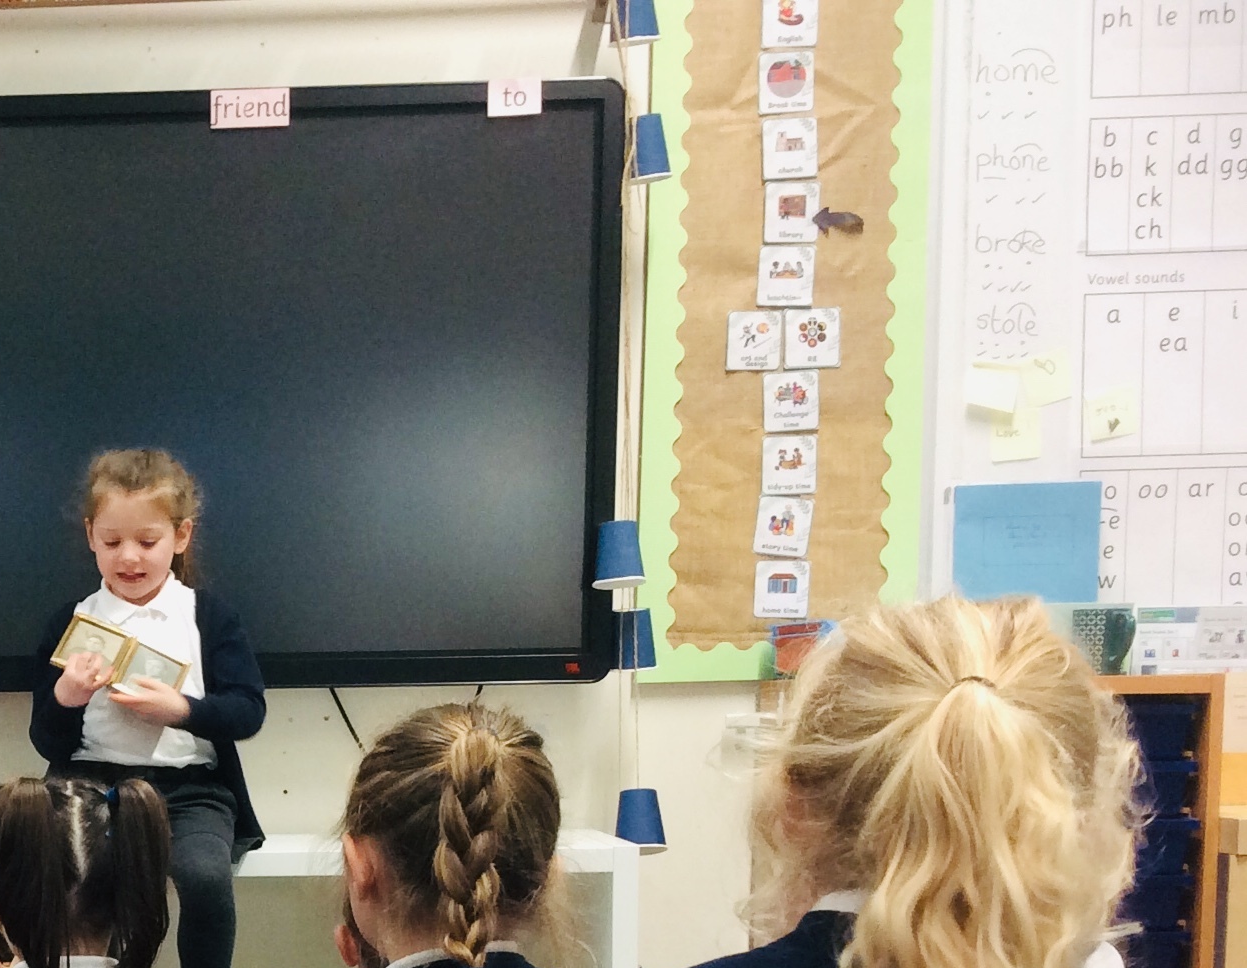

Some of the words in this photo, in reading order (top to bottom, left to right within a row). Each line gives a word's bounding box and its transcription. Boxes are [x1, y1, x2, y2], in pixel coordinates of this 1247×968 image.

[1101, 5, 1133, 35] ph
[1156, 4, 1178, 27] le
[1198, 2, 1236, 25] mb
[975, 54, 1059, 85] home
[502, 86, 527, 108] to
[211, 92, 288, 126] friend
[1103, 125, 1117, 148] b
[1187, 122, 1201, 145] d
[1229, 126, 1242, 149] g
[975, 143, 1051, 183] phone
[1094, 156, 1124, 179] bb
[1145, 155, 1157, 177] k
[1177, 153, 1209, 176] dd
[1136, 185, 1163, 208] ck
[974, 224, 1046, 255] broke
[1135, 217, 1163, 240] ch
[1088, 272, 1129, 285] Vowel
[1135, 270, 1185, 284] sounds
[976, 305, 1039, 337] stole
[1106, 307, 1121, 324] a
[1167, 306, 1180, 322] e
[1158, 336, 1188, 353] ea
[1138, 483, 1169, 499] oo
[1188, 482, 1215, 498] ar
